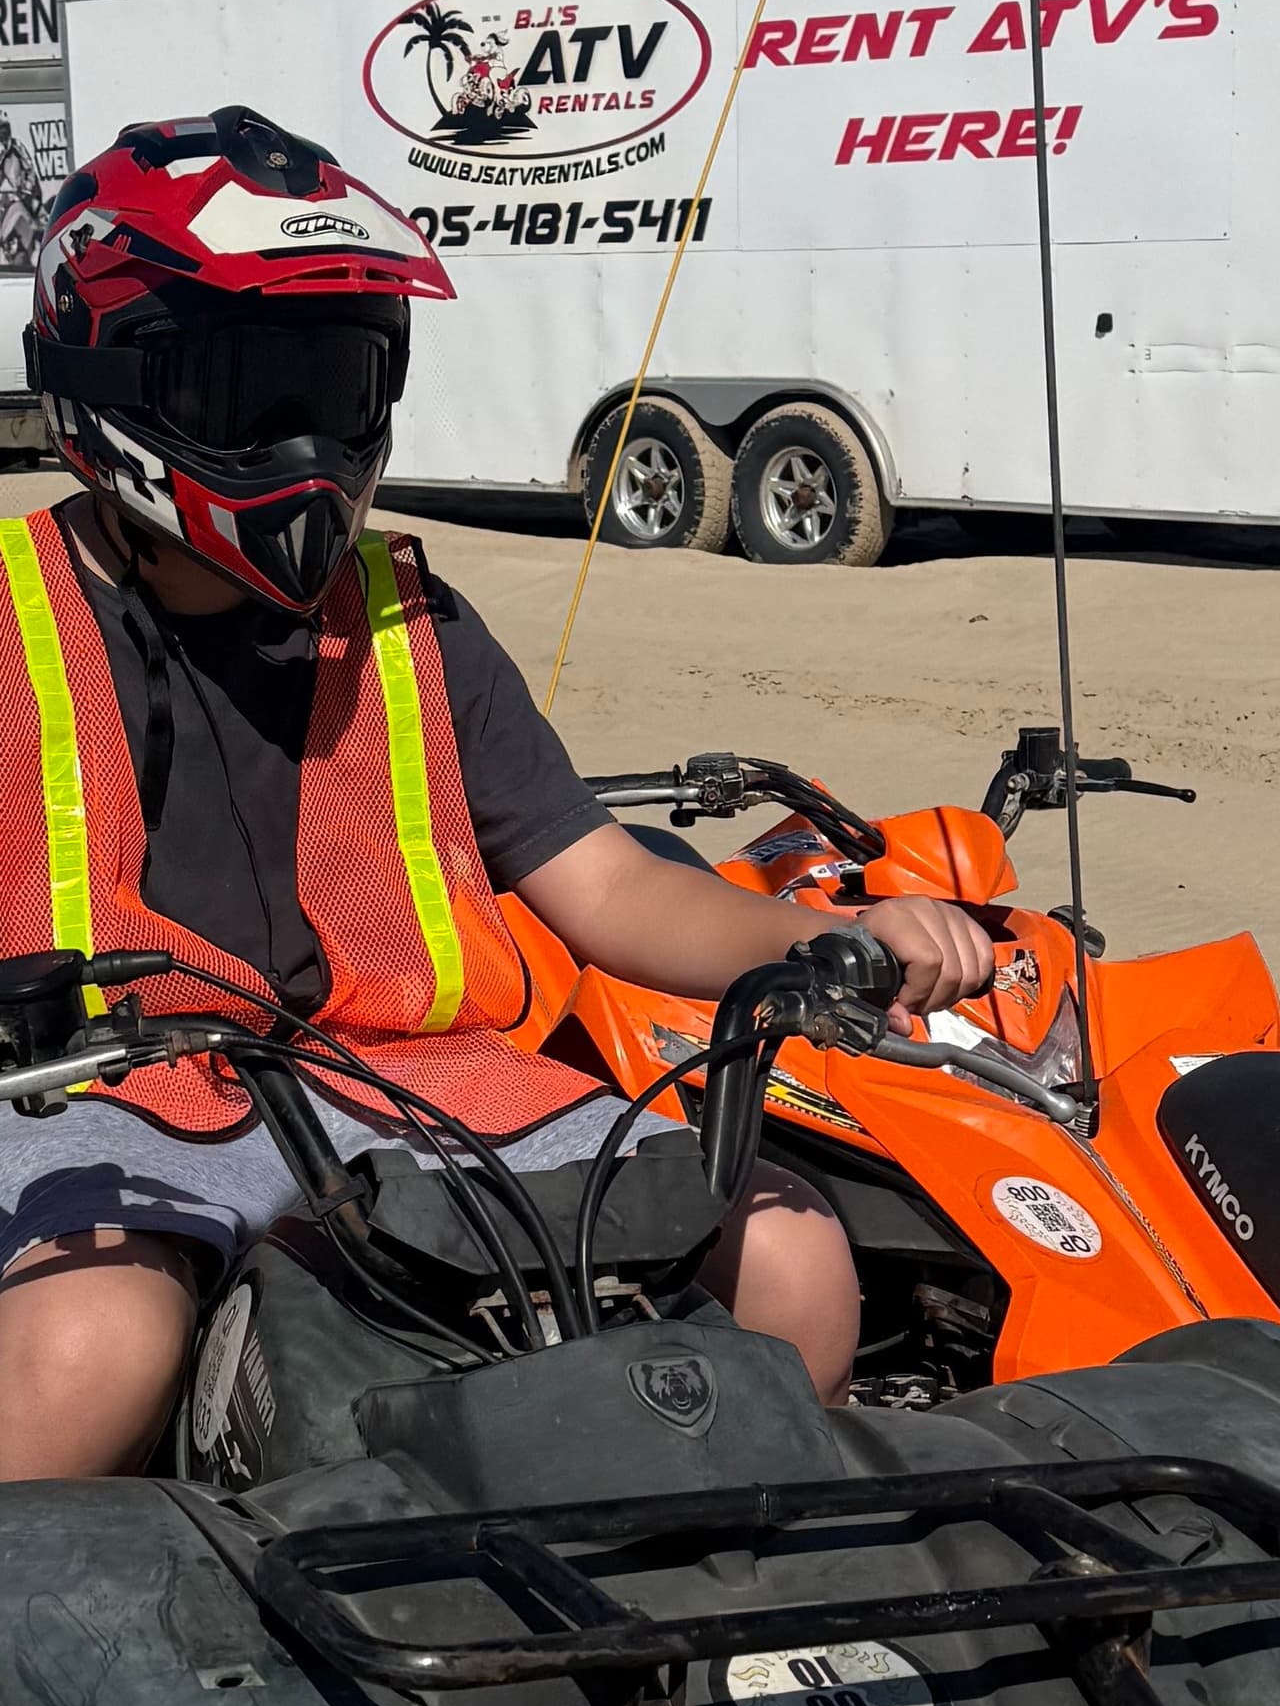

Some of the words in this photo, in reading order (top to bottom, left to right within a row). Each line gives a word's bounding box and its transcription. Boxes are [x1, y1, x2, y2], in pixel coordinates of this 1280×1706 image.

[514, 4, 579, 30] B.J.'S
[742, 5, 956, 70] RENT
[517, 20, 669, 86] ATV
[537, 89, 656, 115] RENTALS
[407, 132, 666, 187] WWW.BJSATVRENTALS.COM
[834, 104, 1084, 166] HERE!
[1184, 1133, 1255, 1241] KYMCO
